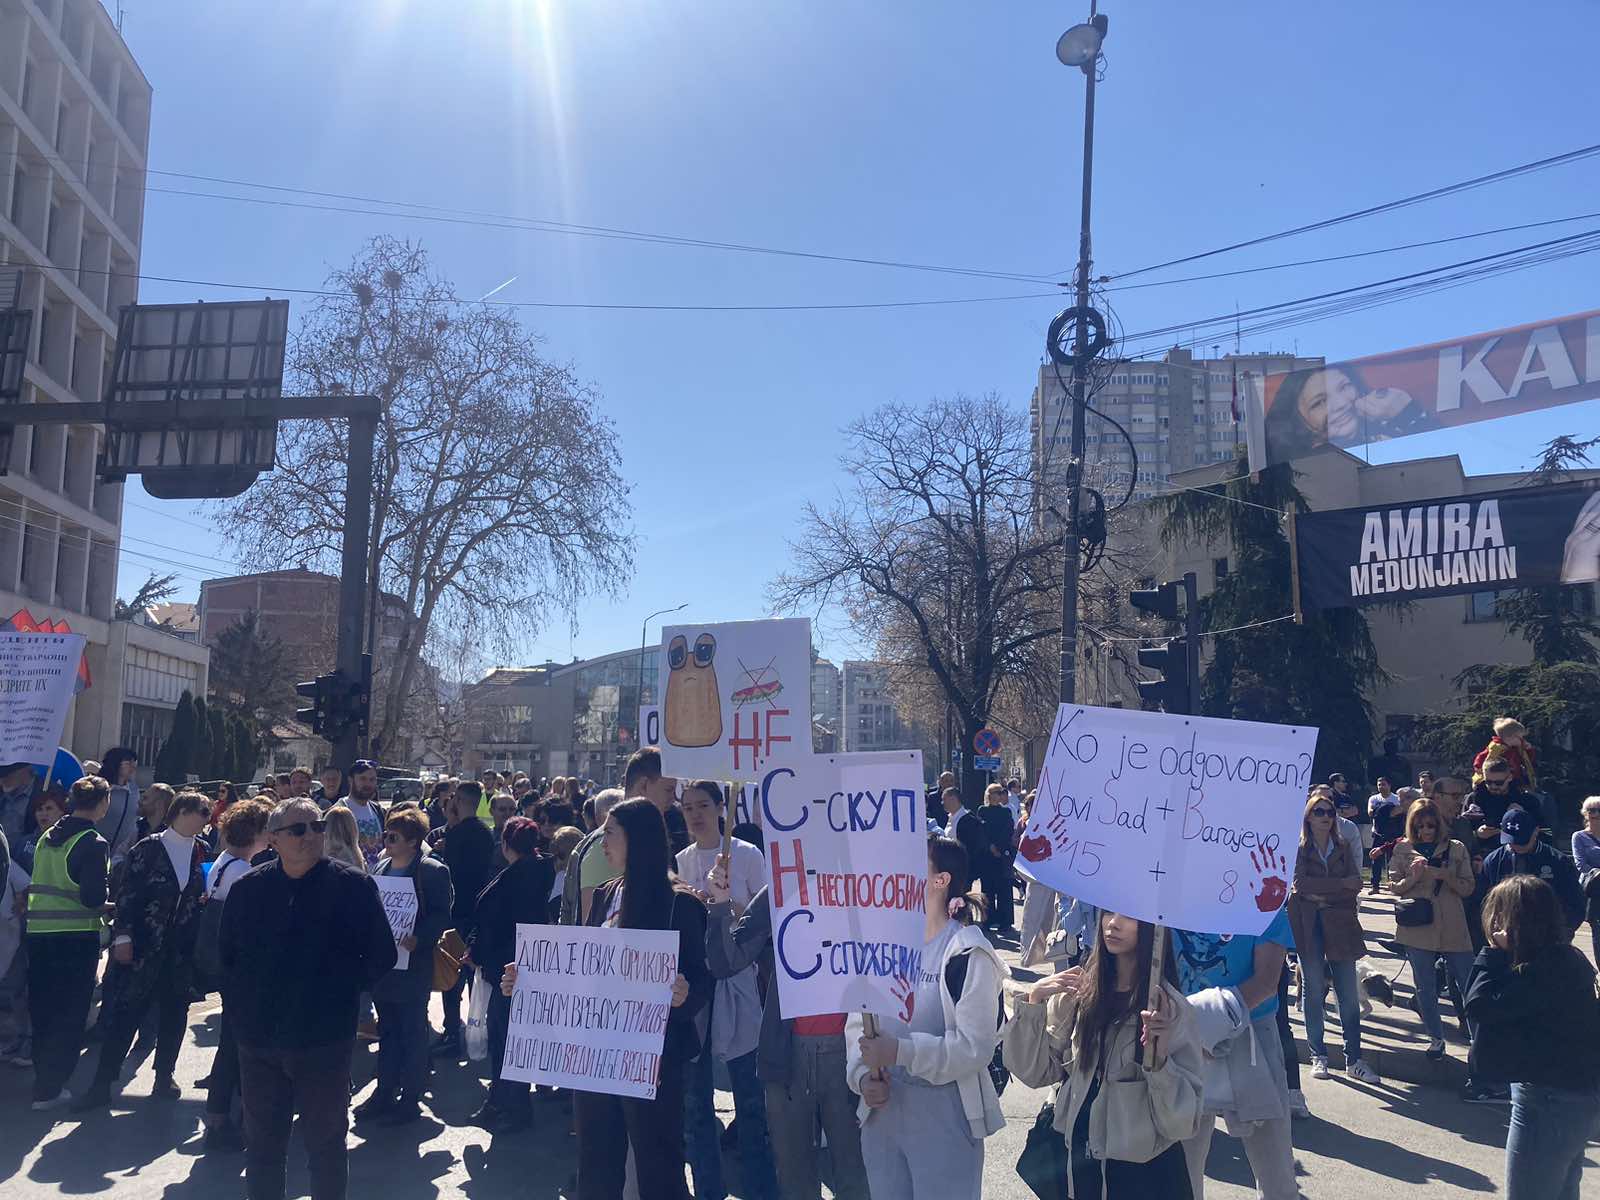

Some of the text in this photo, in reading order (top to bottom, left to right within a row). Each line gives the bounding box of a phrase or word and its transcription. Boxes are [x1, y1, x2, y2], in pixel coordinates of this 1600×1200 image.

[1437, 316, 1600, 412] KA
[1359, 499, 1505, 564] AMIRA
[1350, 546, 1518, 597] MEDUNJANIN
[1051, 707, 1312, 791] Ko je odgovoran?
[1034, 766, 1093, 822] Novi
[1097, 776, 1149, 834] Sad
[1182, 787, 1281, 853] Barajevo
[1064, 840, 1107, 877] 15
[1218, 870, 1239, 904] 8
[581, 941, 617, 976] ОВИХ
[511, 988, 525, 1024] СА
[526, 990, 568, 1028] ПУНОМ
[571, 993, 621, 1030] ВРЕЋОМ
[539, 1041, 562, 1071] ШТО
